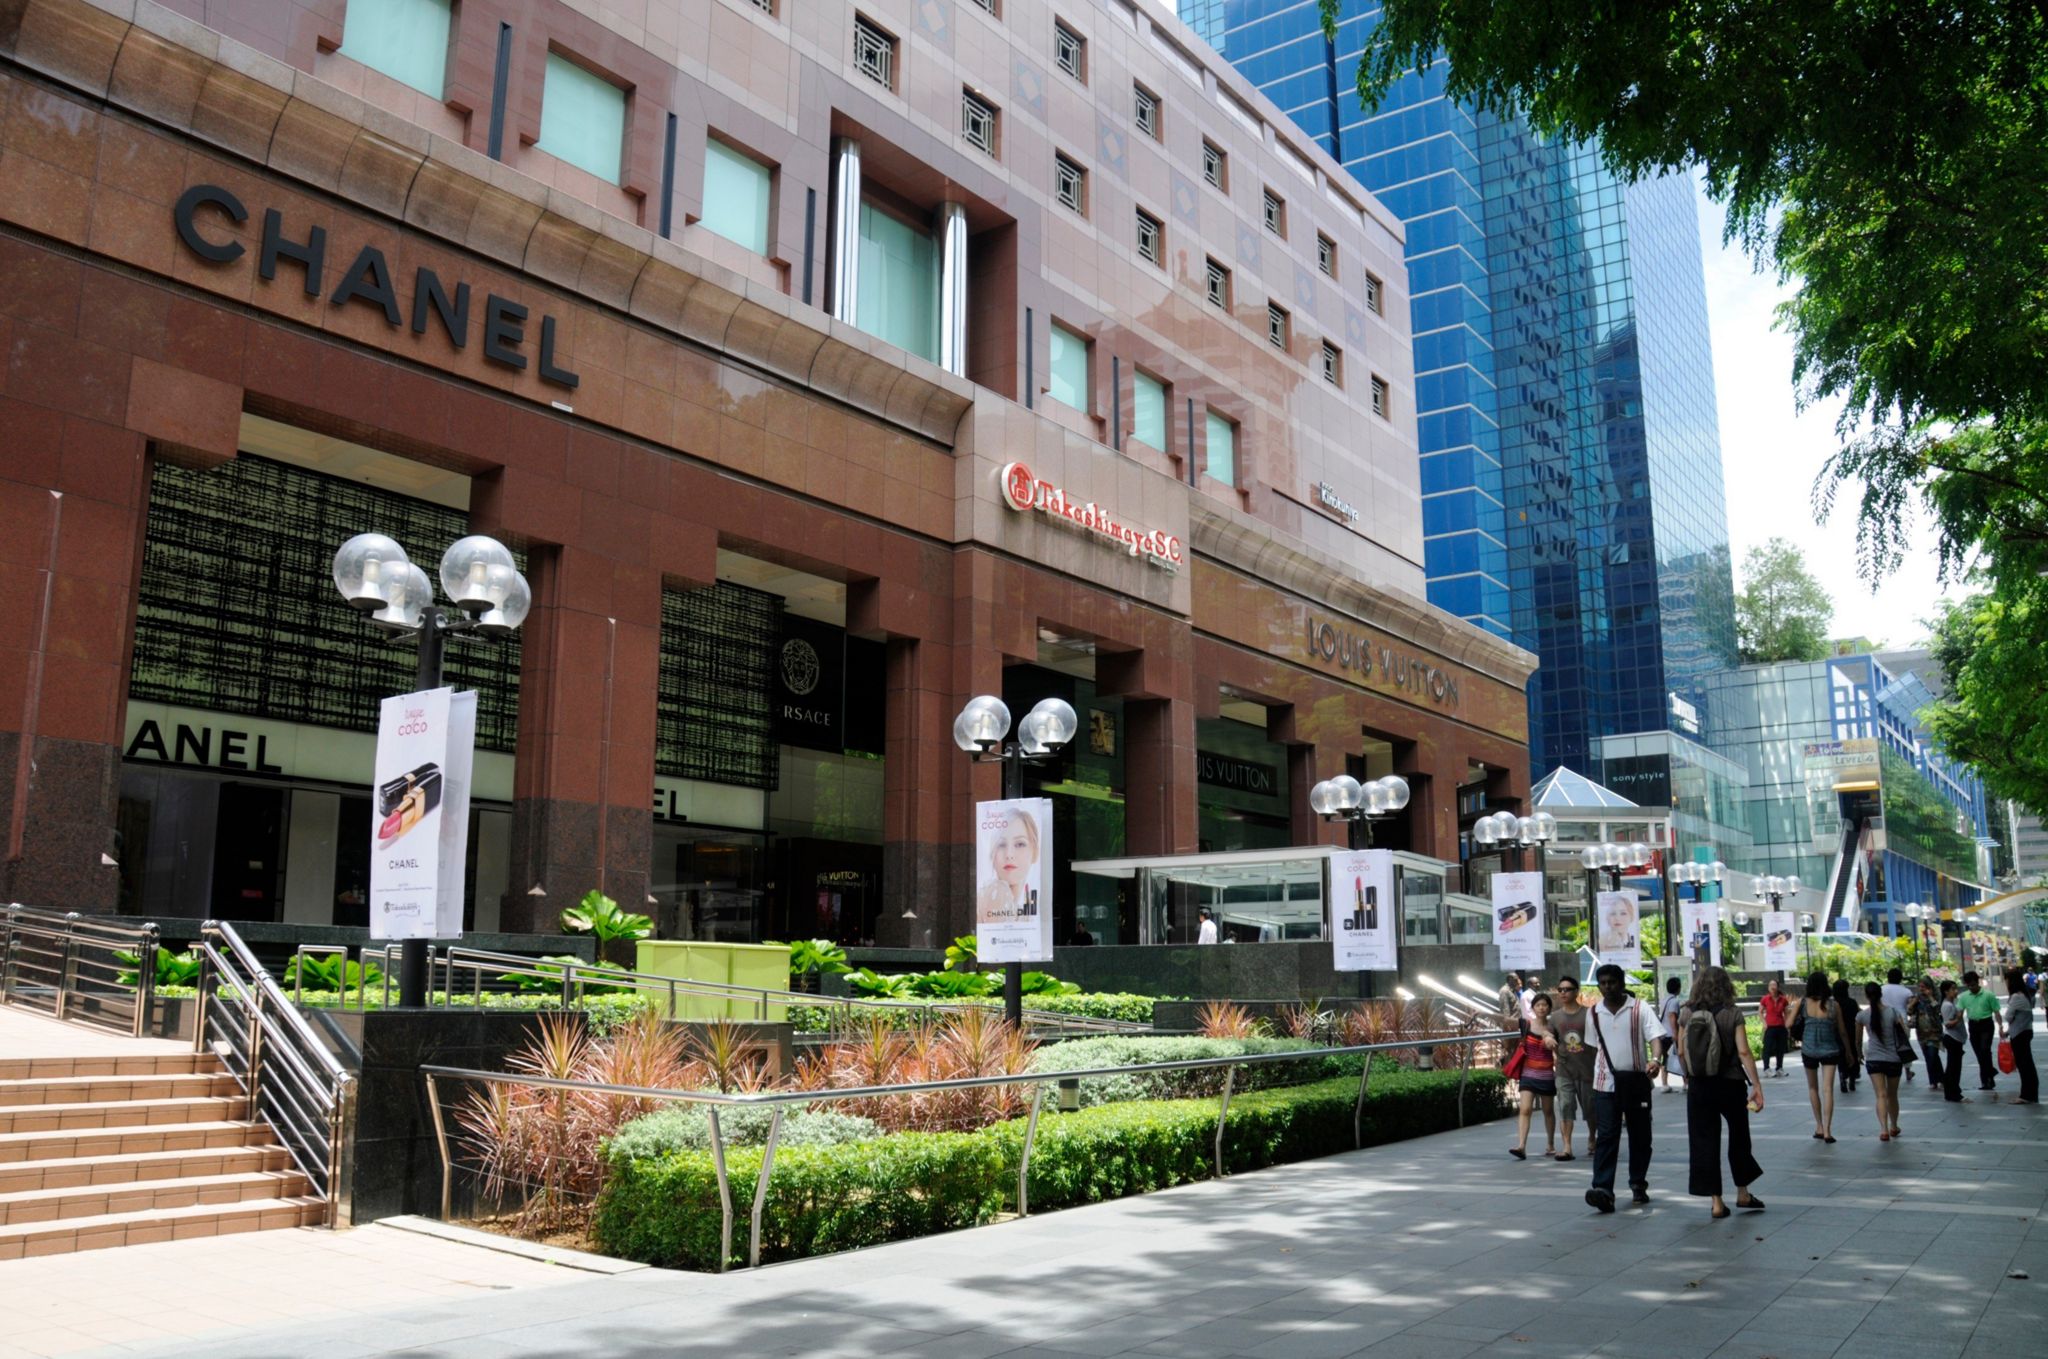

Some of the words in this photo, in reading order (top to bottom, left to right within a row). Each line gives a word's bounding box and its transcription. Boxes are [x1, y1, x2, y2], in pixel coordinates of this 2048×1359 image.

[174, 184, 579, 388] CHANEL
[1036, 479, 1157, 555] Takashimaya
[1152, 530, 1184, 564] S.C.
[1307, 617, 1373, 676] LOUIS
[1377, 646, 1459, 706] VUITTON
[398, 721, 428, 736] COCO
[126, 719, 282, 774] ANEL
[1216, 760, 1270, 790] VUITTON
[1612, 775, 1637, 785] sony
[981, 820, 1009, 830] COCO
[389, 858, 420, 870] CHANEL
[987, 909, 1015, 918] CHANEL
